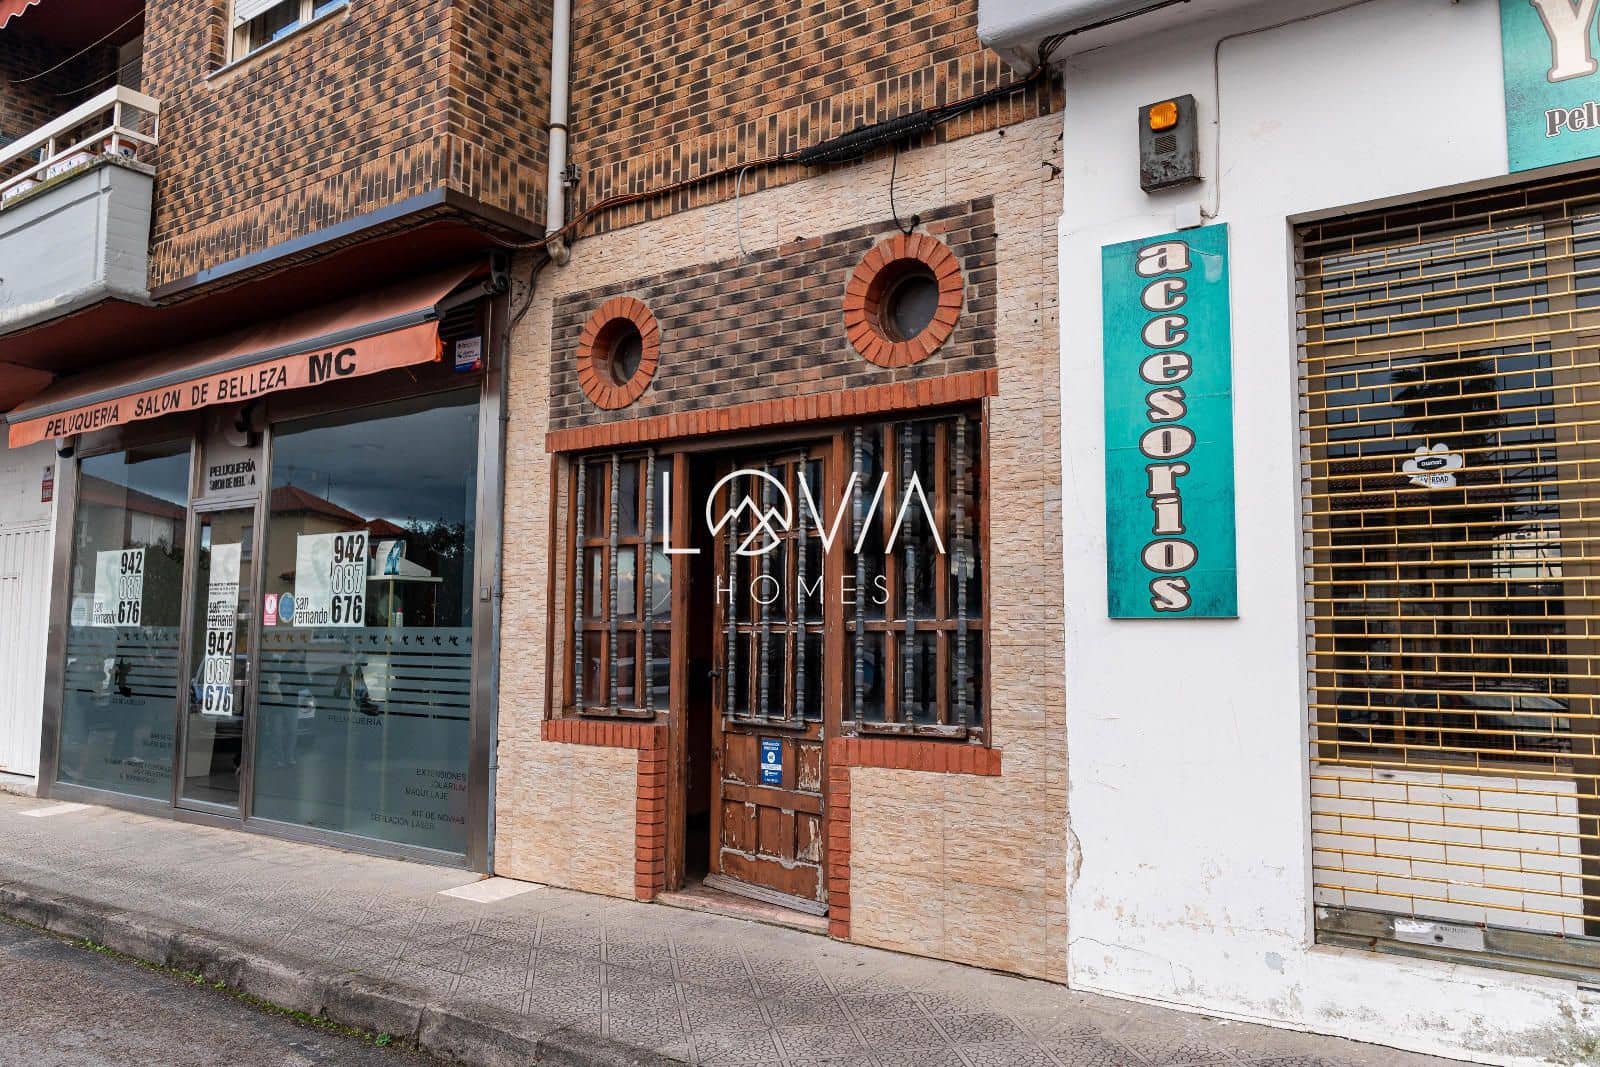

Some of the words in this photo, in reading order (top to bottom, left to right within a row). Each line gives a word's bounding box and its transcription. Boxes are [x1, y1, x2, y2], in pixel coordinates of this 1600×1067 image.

[1545, 101, 1600, 137] Pel
[45, 404, 119, 438] PELUQUERIA
[134, 389, 181, 417] SALON
[192, 383, 209, 406] DE
[217, 365, 288, 401] BELLEZA
[308, 347, 357, 384] MC
[1135, 239, 1199, 612] accesorios
[233, 474, 256, 488] BELLA
[333, 534, 366, 563] 942
[120, 551, 143, 575] 942
[119, 576, 142, 600] 087
[332, 564, 364, 594] 087
[118, 600, 140, 624] 676
[294, 608, 328, 625] fernando
[331, 595, 363, 623] 676
[295, 597, 309, 610] san
[207, 631, 233, 656] 942
[205, 658, 232, 684] 087
[204, 685, 232, 712] 676
[431, 780, 466, 792] OLARIUM
